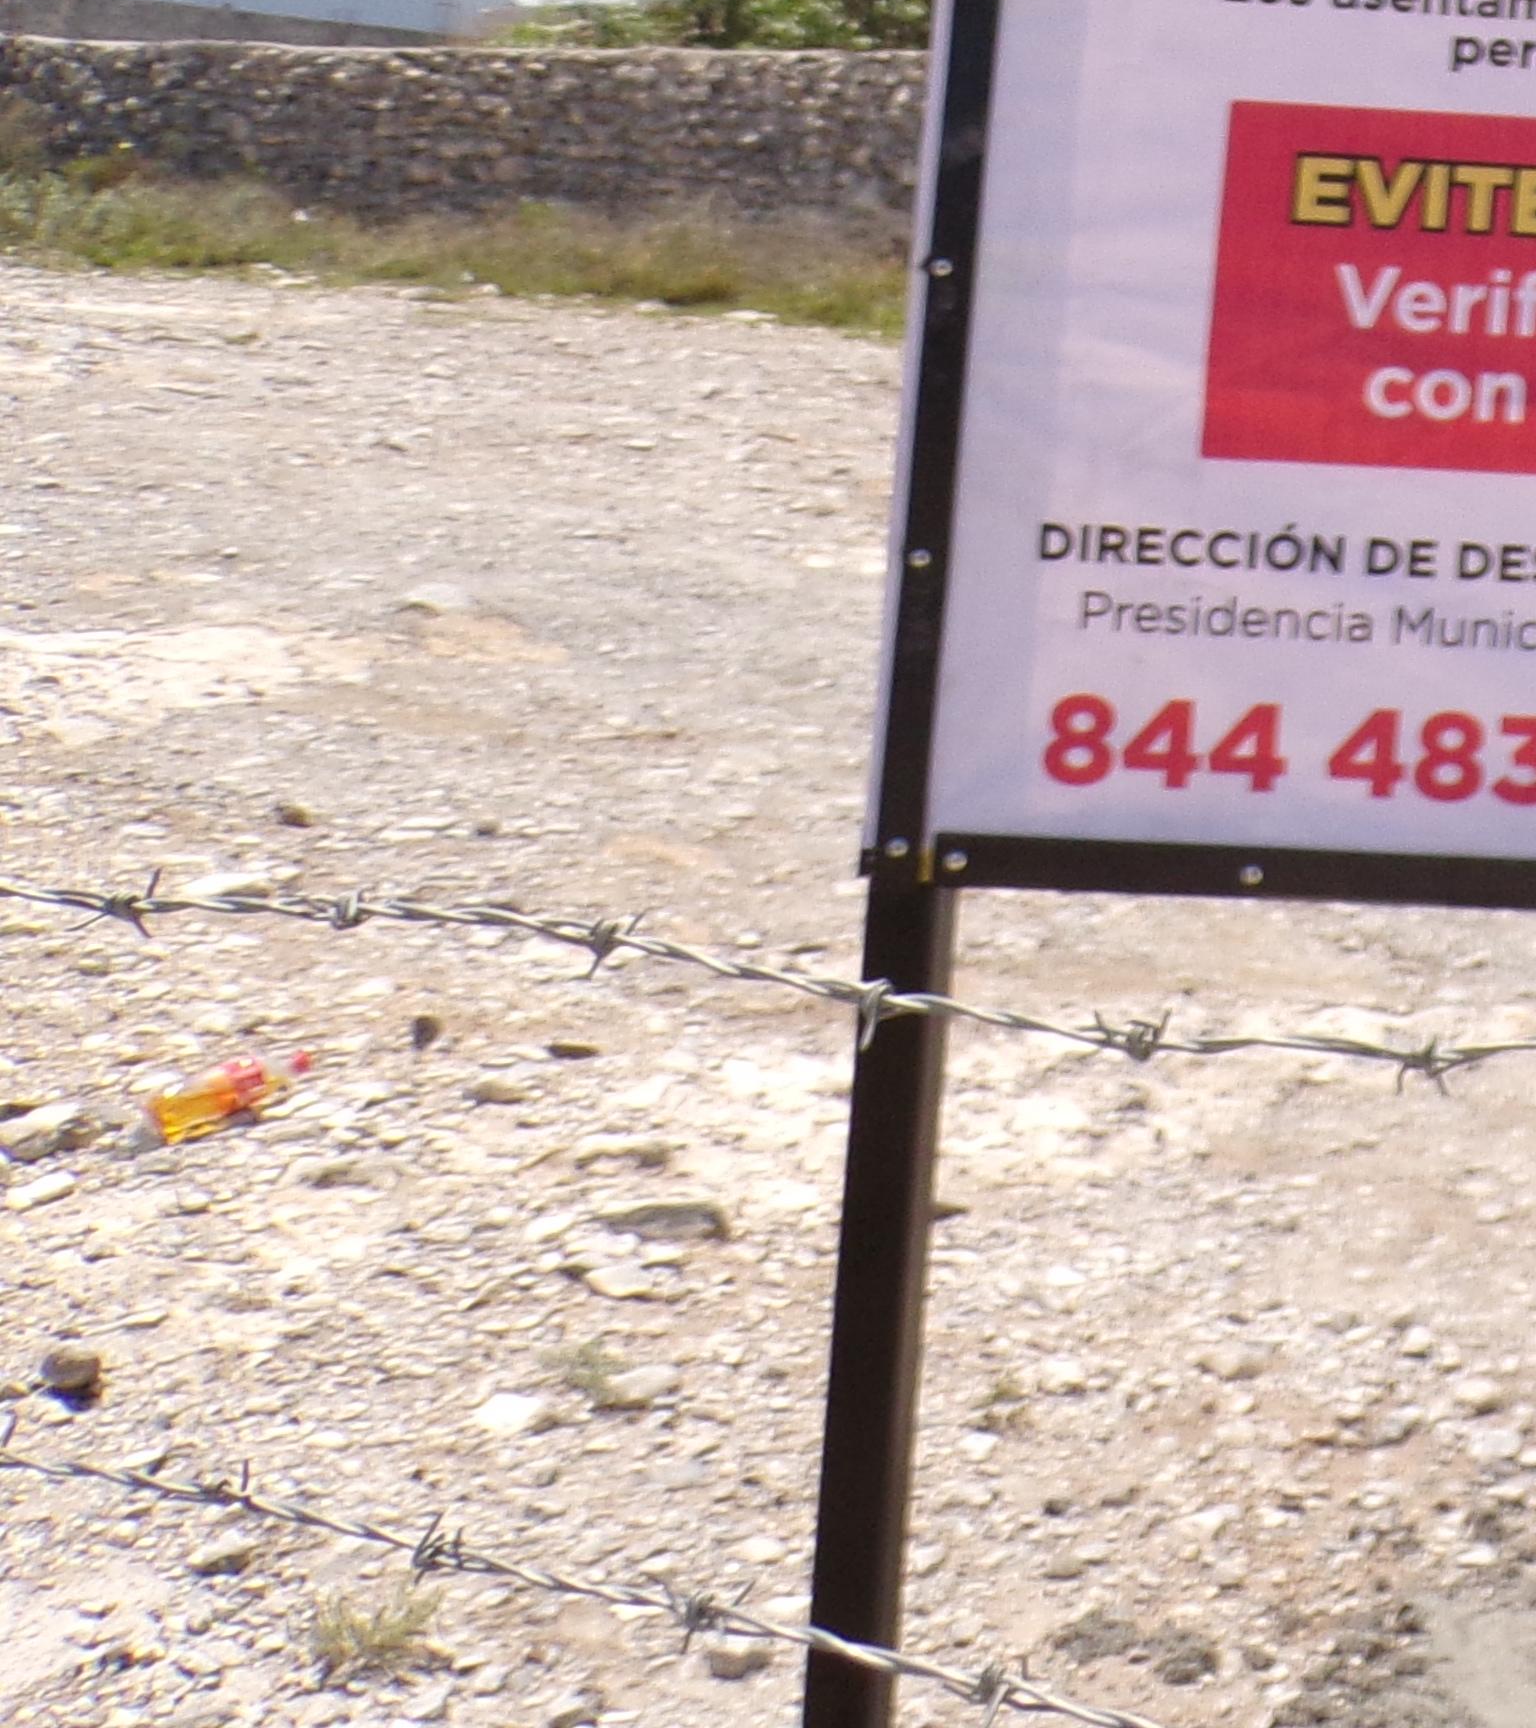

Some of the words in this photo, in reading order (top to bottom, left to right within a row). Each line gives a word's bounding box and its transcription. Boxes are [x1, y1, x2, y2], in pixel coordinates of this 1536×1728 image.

[1361, 365, 1528, 427] con
[1036, 521, 1348, 576] DIRECCIÓN
[1361, 536, 1440, 580] DE
[1074, 589, 1376, 646] Presidencia
[1041, 692, 1289, 795] 844
